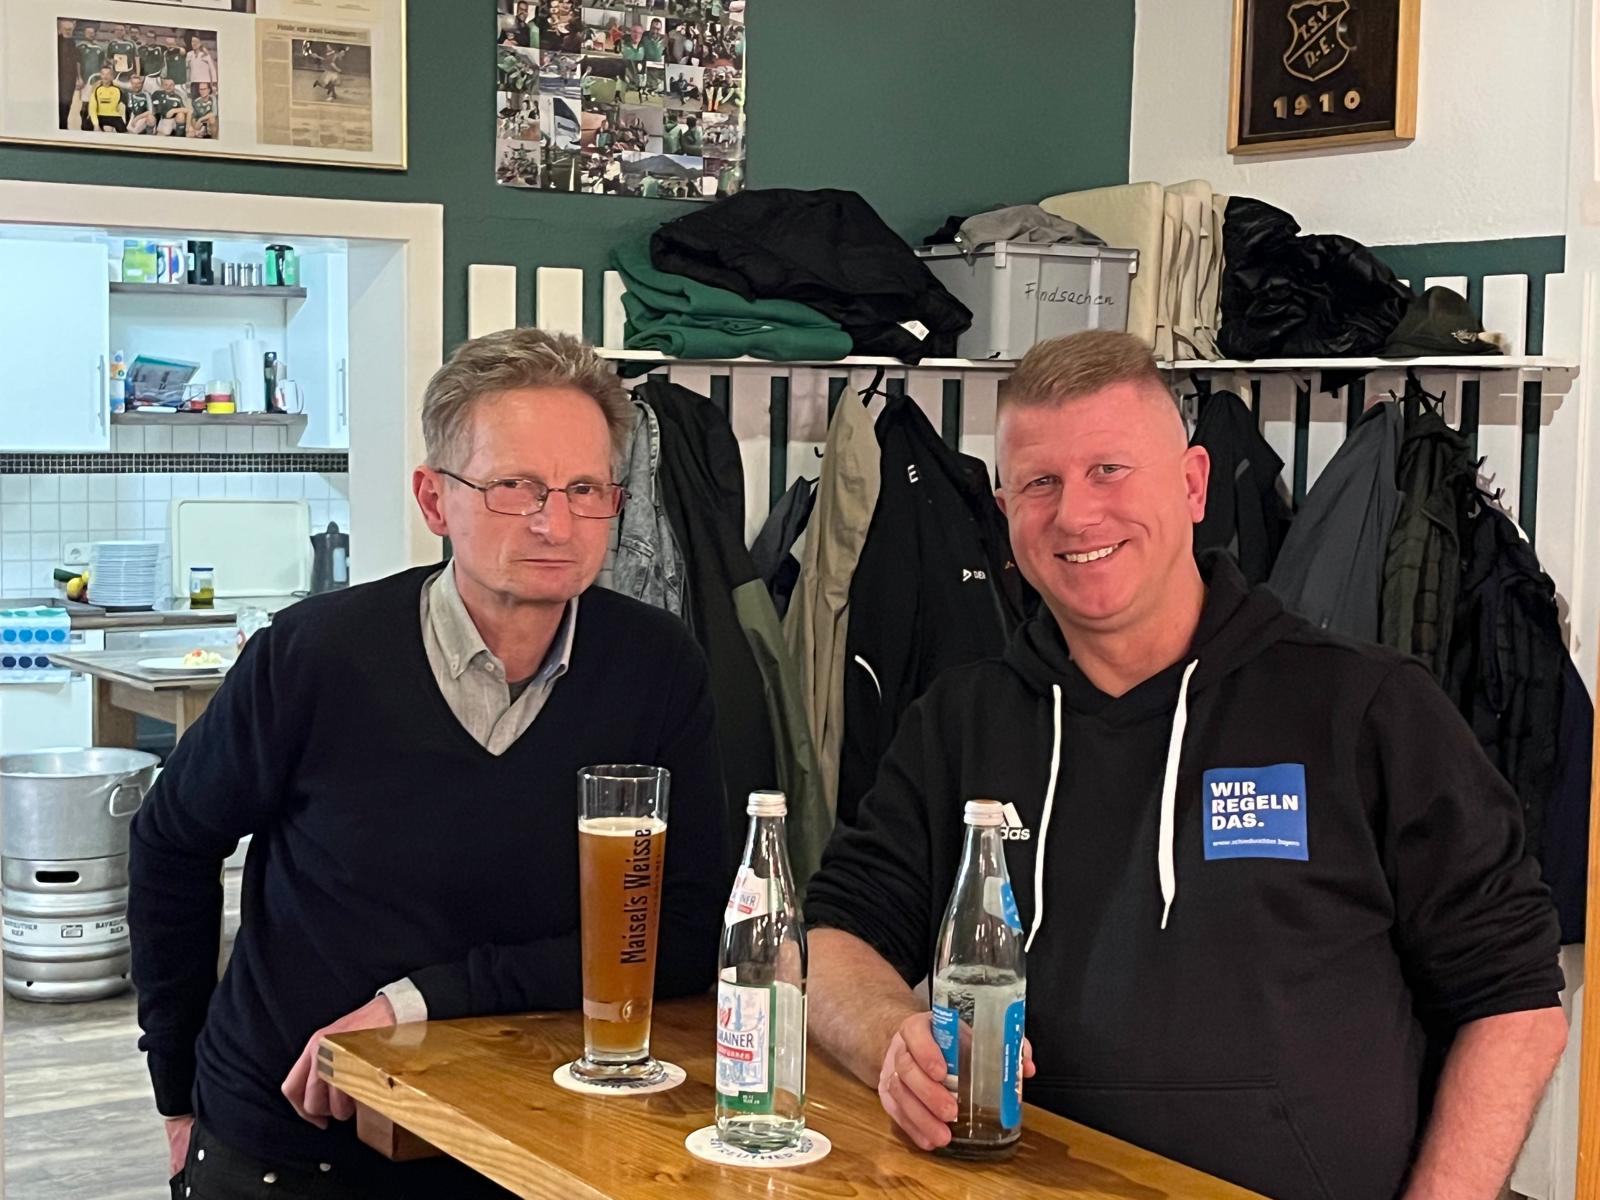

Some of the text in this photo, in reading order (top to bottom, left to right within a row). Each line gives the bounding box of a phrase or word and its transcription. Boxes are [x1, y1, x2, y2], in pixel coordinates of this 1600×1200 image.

[1273, 90, 1361, 119] 1910
[1210, 781, 1256, 797] WIR
[1211, 794, 1298, 814] REGELN
[1211, 813, 1265, 831] DAS.
[1000, 826, 1031, 841] das
[620, 828, 652, 964] Maisel's Weisse
